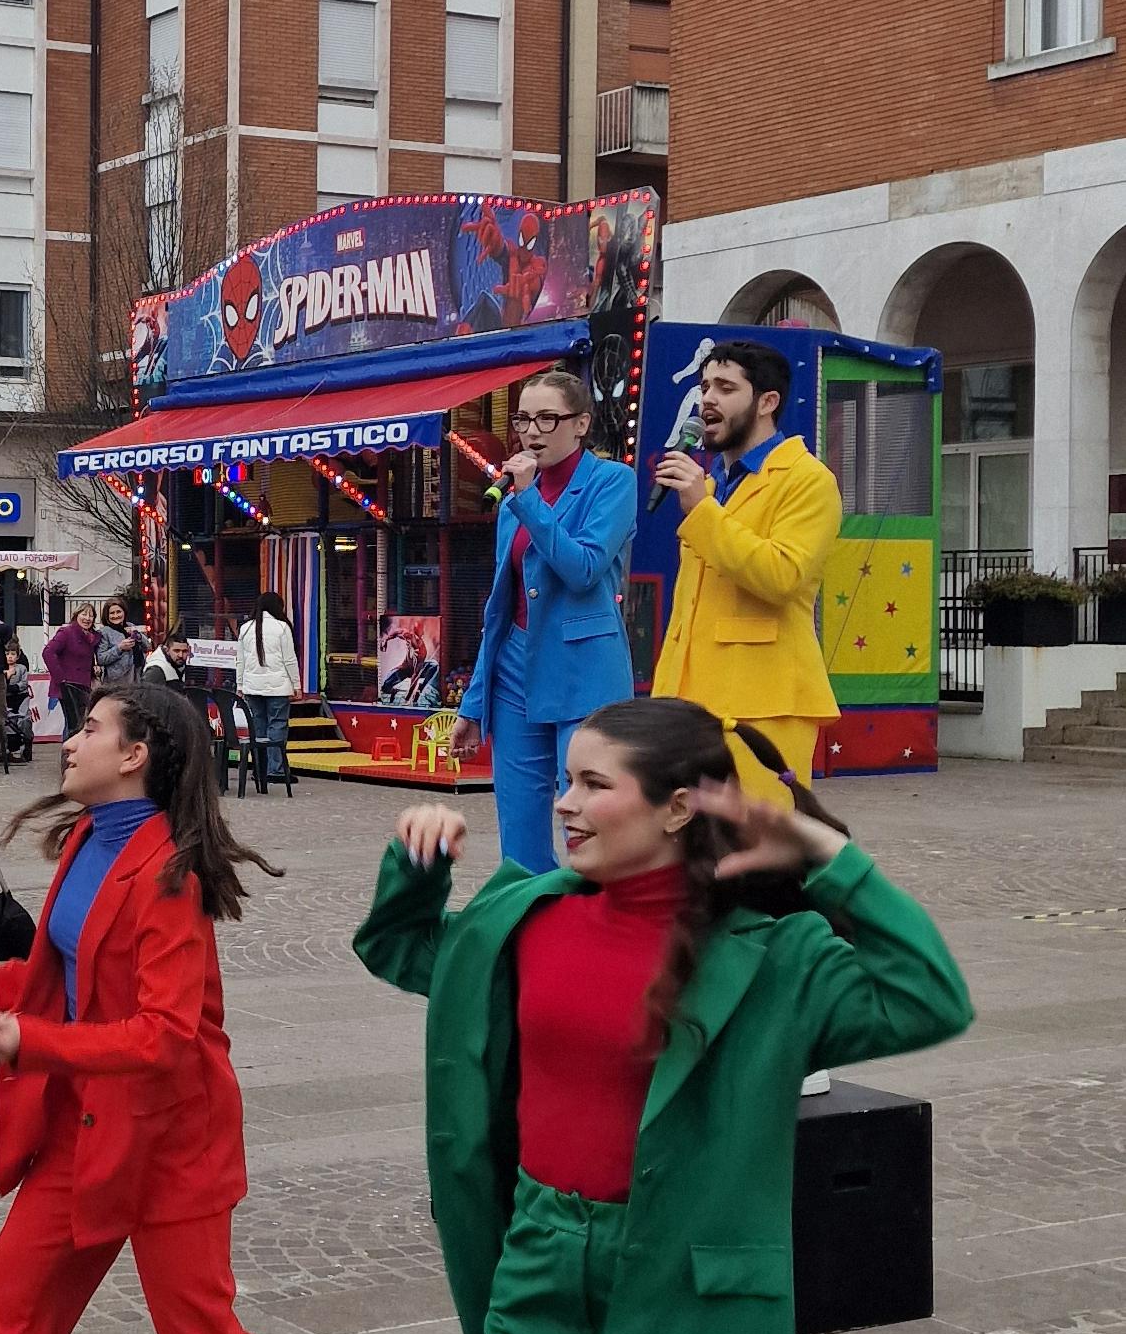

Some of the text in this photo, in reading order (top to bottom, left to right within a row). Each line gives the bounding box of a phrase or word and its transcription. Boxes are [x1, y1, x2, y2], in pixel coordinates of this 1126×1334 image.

[336, 229, 364, 252] MARVEL
[273, 248, 437, 348] SPIDER-MAN
[73, 422, 410, 473] PERCORSO FANTASTICO
